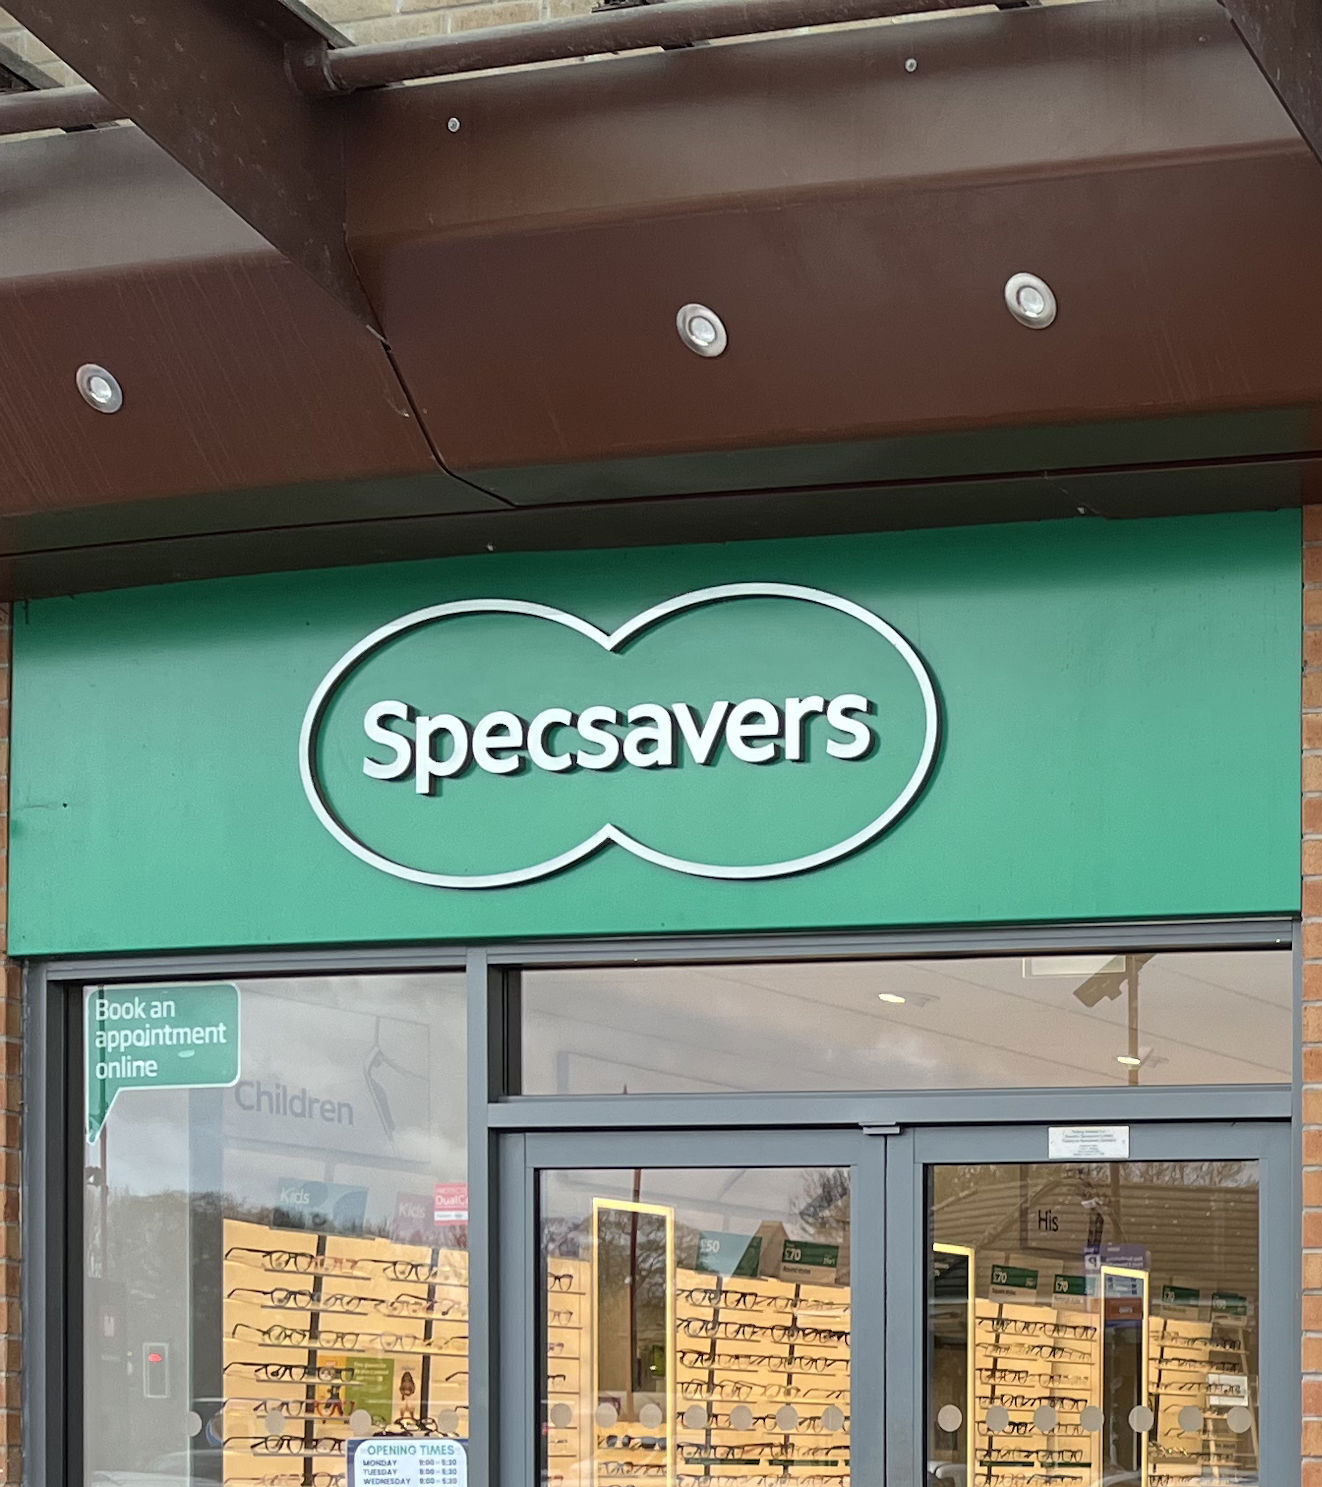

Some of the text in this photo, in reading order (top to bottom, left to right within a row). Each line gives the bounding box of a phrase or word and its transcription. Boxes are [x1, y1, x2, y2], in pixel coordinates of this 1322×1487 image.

[363, 693, 875, 796] Specsavers
[95, 997, 176, 1021] Book an
[95, 1023, 227, 1052] appointment
[95, 1056, 158, 1079] online
[234, 1080, 354, 1126] Children
[281, 1187, 310, 1204] Kids
[400, 1203, 426, 1218] Kids
[1038, 1209, 1059, 1232] His
[367, 1445, 455, 1455] OPENING TIMES
